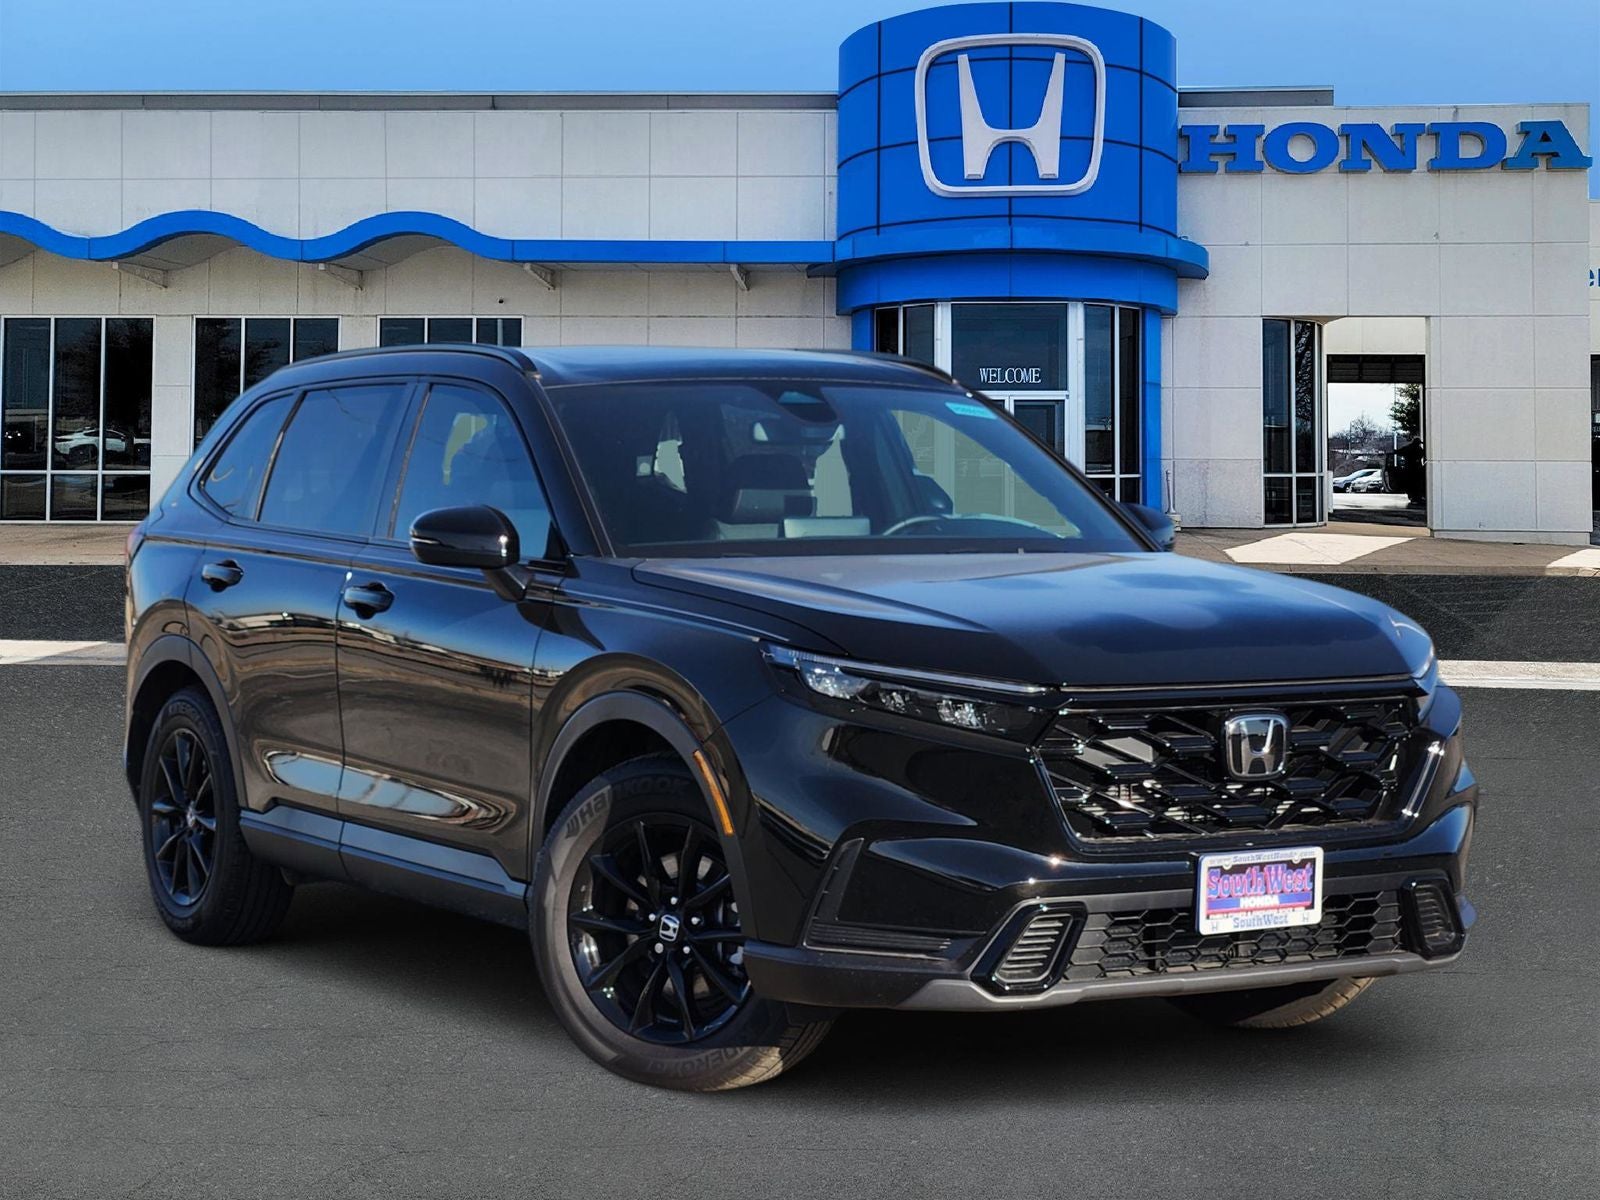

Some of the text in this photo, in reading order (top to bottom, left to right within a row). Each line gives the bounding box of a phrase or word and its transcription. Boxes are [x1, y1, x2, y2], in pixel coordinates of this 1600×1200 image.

[1179, 120, 1593, 174] HONDA
[979, 367, 1042, 384] WELCOME
[1240, 895, 1280, 908] HONDA
[1232, 913, 1289, 929] SouthWest
